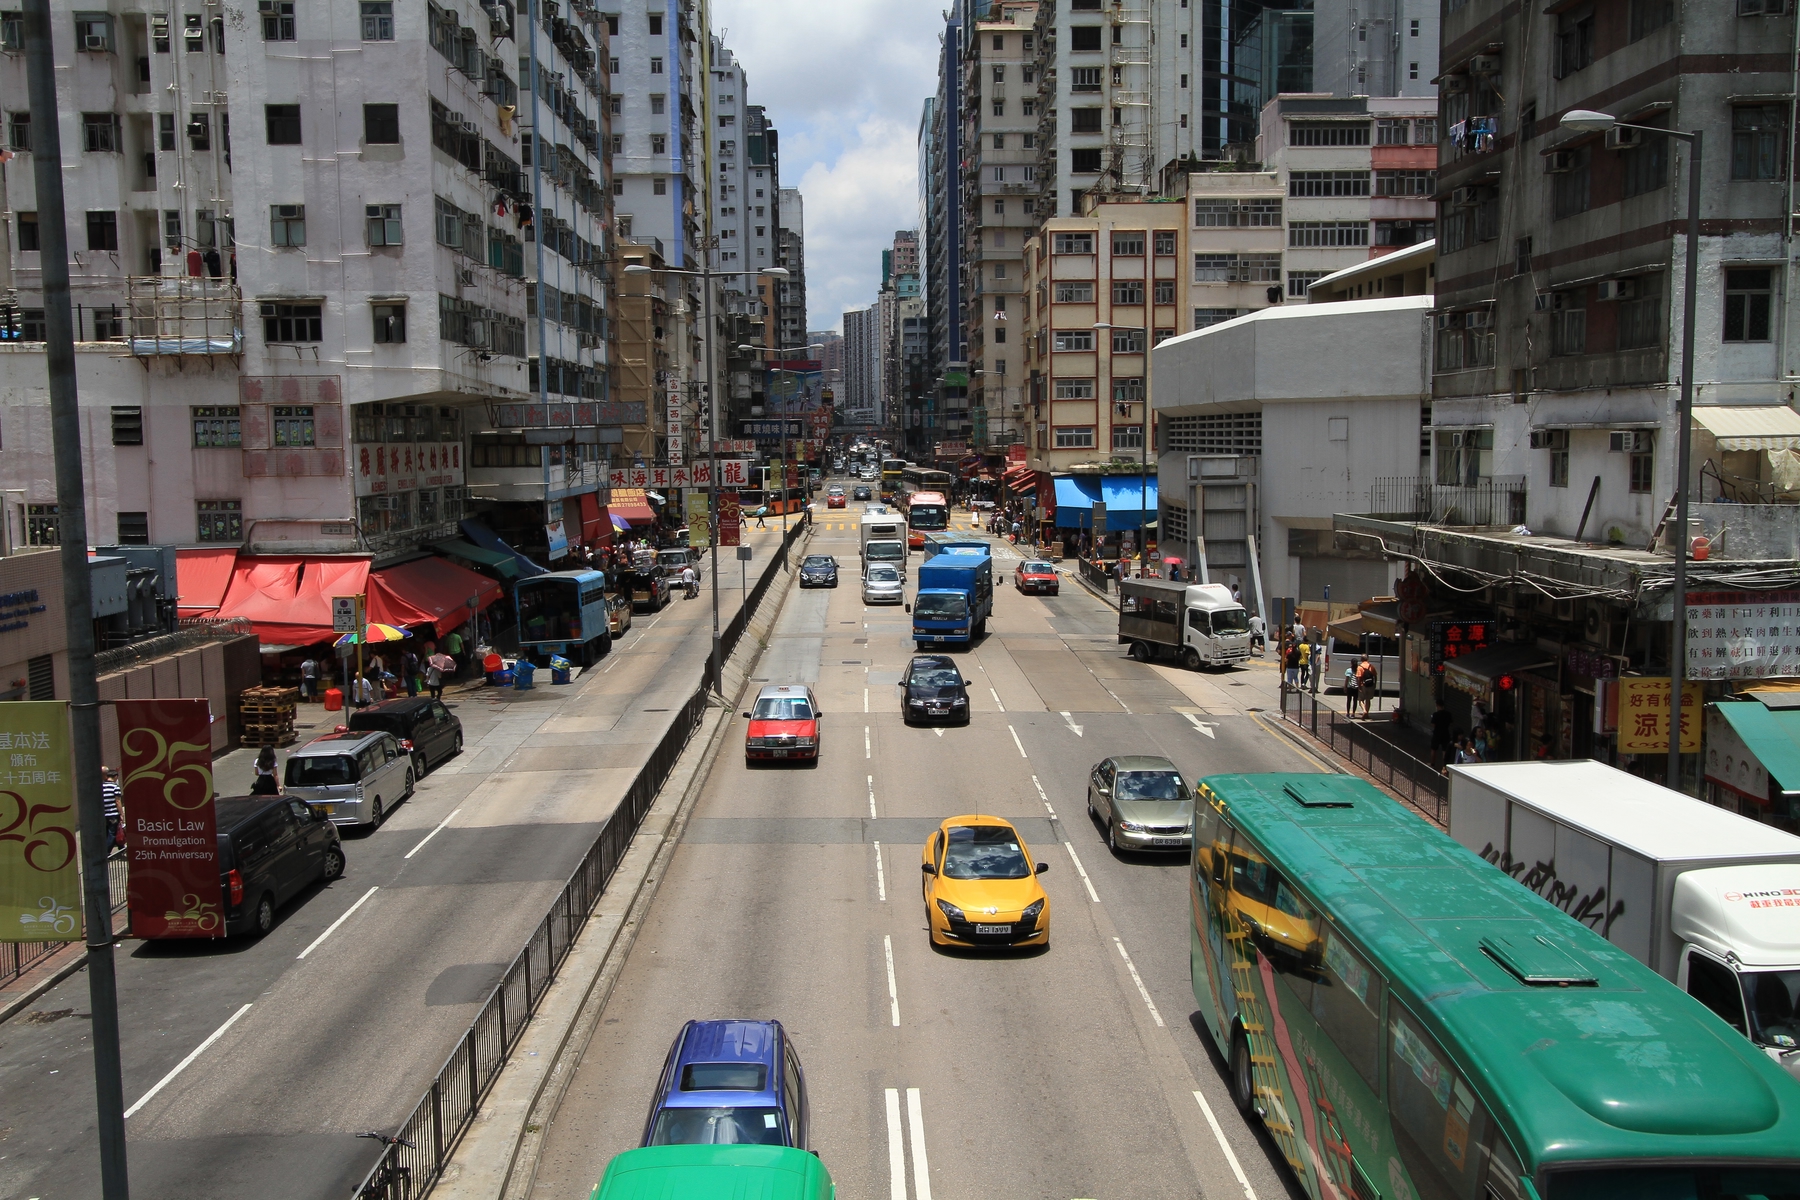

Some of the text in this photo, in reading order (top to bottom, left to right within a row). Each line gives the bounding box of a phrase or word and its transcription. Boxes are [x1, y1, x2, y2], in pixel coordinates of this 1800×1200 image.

[719, 498, 740, 518] 25
[688, 512, 708, 532] 25
[1446, 625, 1485, 642] 金源
[0, 731, 50, 750] 基本法
[10, 754, 37, 767] 頒布
[122, 727, 214, 811] 25
[137, 818, 205, 832] Basic Law
[142, 835, 206, 847] Promulgation
[135, 849, 214, 862] 25th Anniversary
[38, 896, 76, 934] 25
[182, 893, 219, 931] 25
